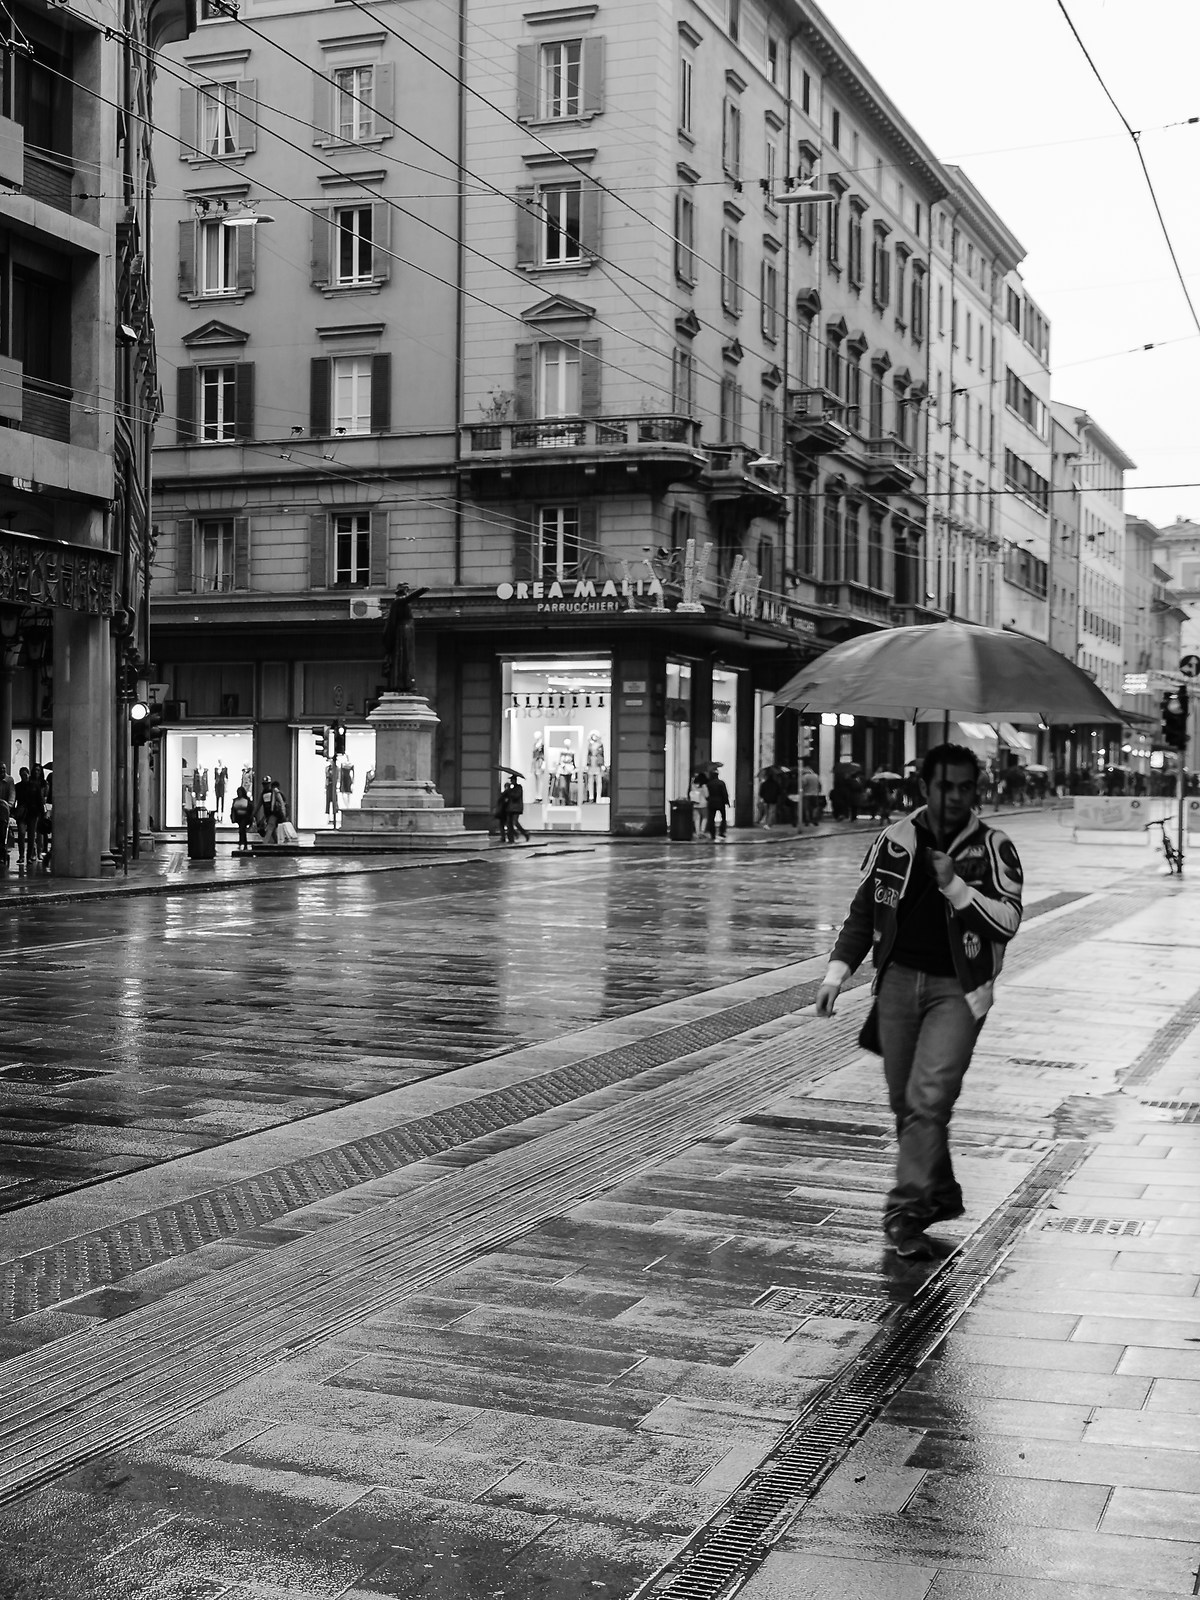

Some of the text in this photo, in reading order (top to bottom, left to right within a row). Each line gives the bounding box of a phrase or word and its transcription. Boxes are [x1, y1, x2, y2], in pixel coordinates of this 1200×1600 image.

[496, 579, 663, 600] OREA MALIA
[537, 601, 619, 613] PARRUCCHIERI
